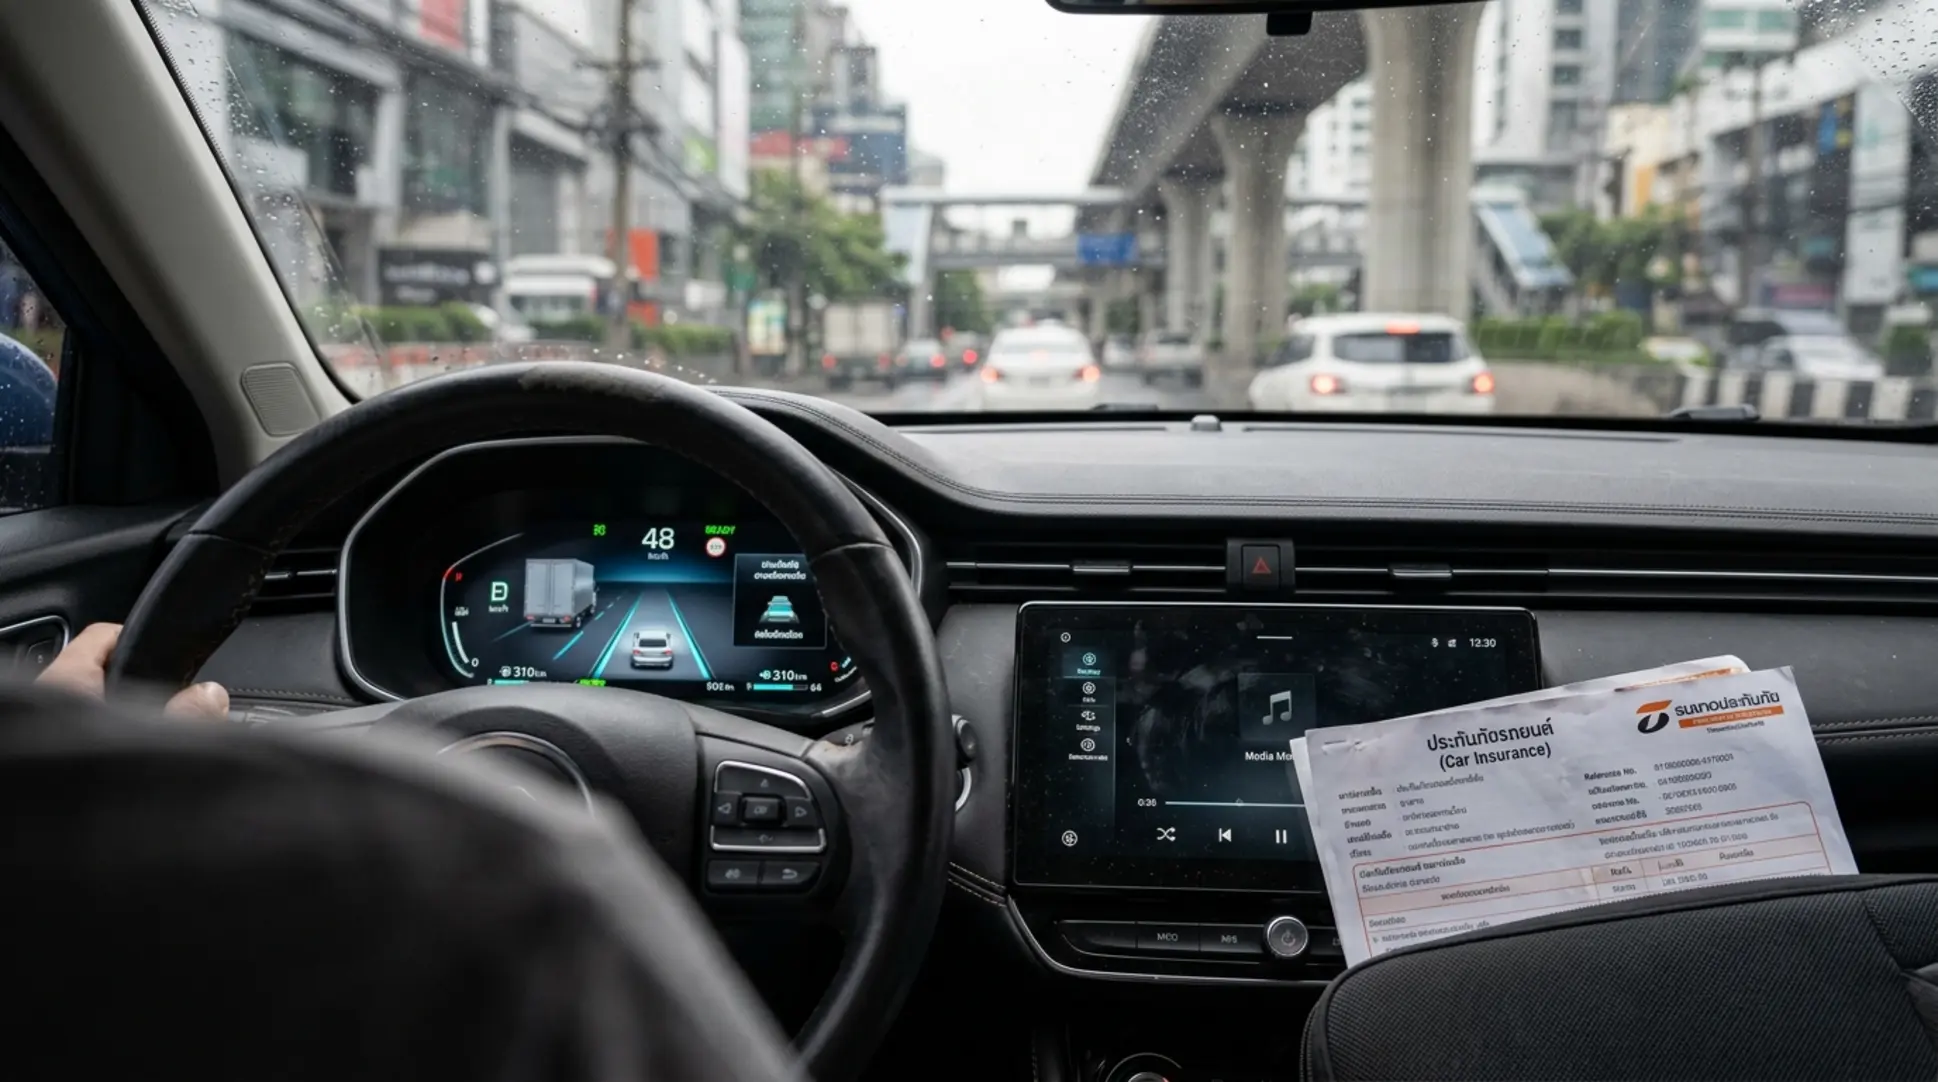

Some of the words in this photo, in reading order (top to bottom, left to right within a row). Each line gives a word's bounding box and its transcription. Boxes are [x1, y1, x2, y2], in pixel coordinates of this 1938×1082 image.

[642, 527, 675, 549] 48
[1439, 754, 1471, 773] (Car
[1474, 742, 1552, 765] Insurance)
